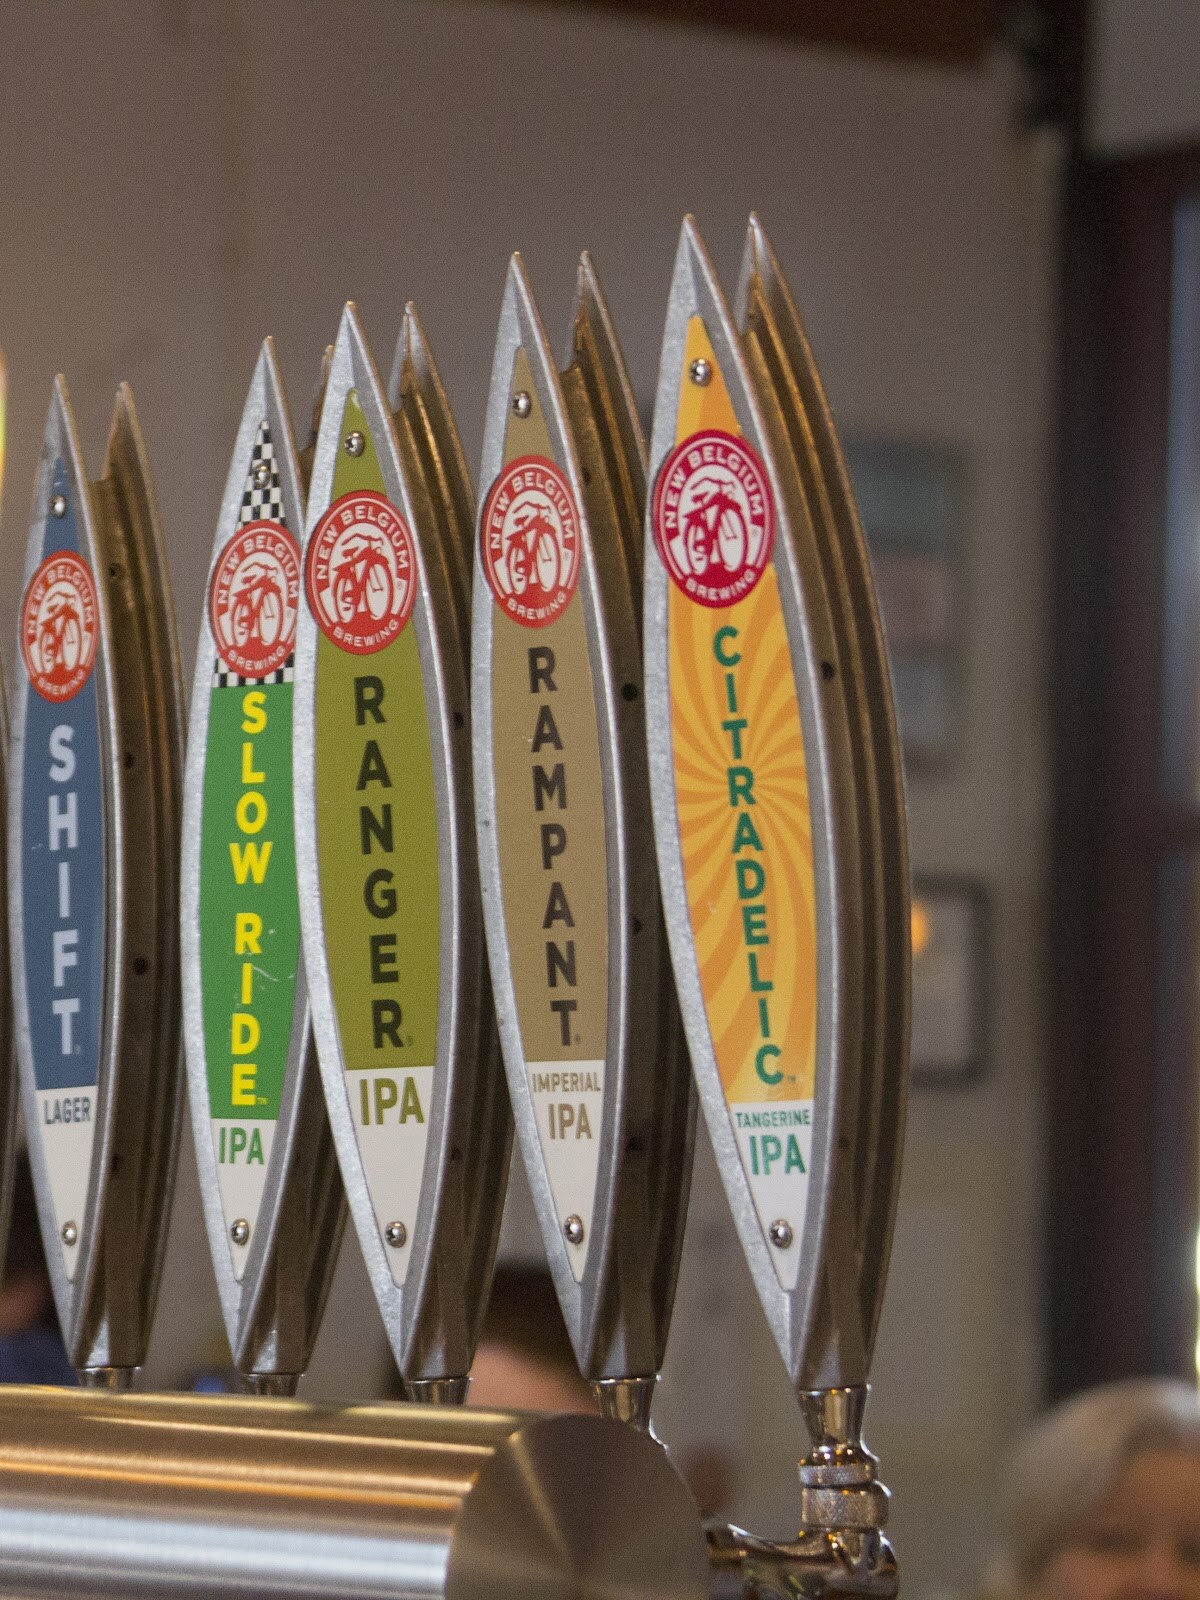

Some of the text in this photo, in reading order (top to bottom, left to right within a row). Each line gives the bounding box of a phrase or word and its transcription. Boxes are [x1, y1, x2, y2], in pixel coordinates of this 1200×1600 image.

[490, 471, 574, 549] NEW BELGIUM
[665, 445, 764, 529] NEW BELGIUM
[316, 505, 410, 580] NEW BELGIUM
[218, 535, 299, 604] NEW BELGIUM
[685, 568, 756, 601] BREWING
[506, 590, 567, 620] BREWING
[333, 618, 400, 647] BREWING
[228, 645, 286, 671] BREWING
[354, 675, 404, 1049] RANGER
[528, 646, 577, 1047] RAMPANT
[713, 625, 784, 1086] CITRADELIC
[48, 724, 81, 1055] SHIFT
[229, 691, 273, 1106] SLOW RIDE
[360, 1076, 425, 1126] IPA
[532, 1072, 601, 1093] IMPERIAL
[43, 1096, 91, 1125] LAGER
[548, 1103, 592, 1140] IPA
[735, 1109, 811, 1128] TANGERINE
[219, 1127, 265, 1165] IPA
[749, 1133, 806, 1176] IPA
